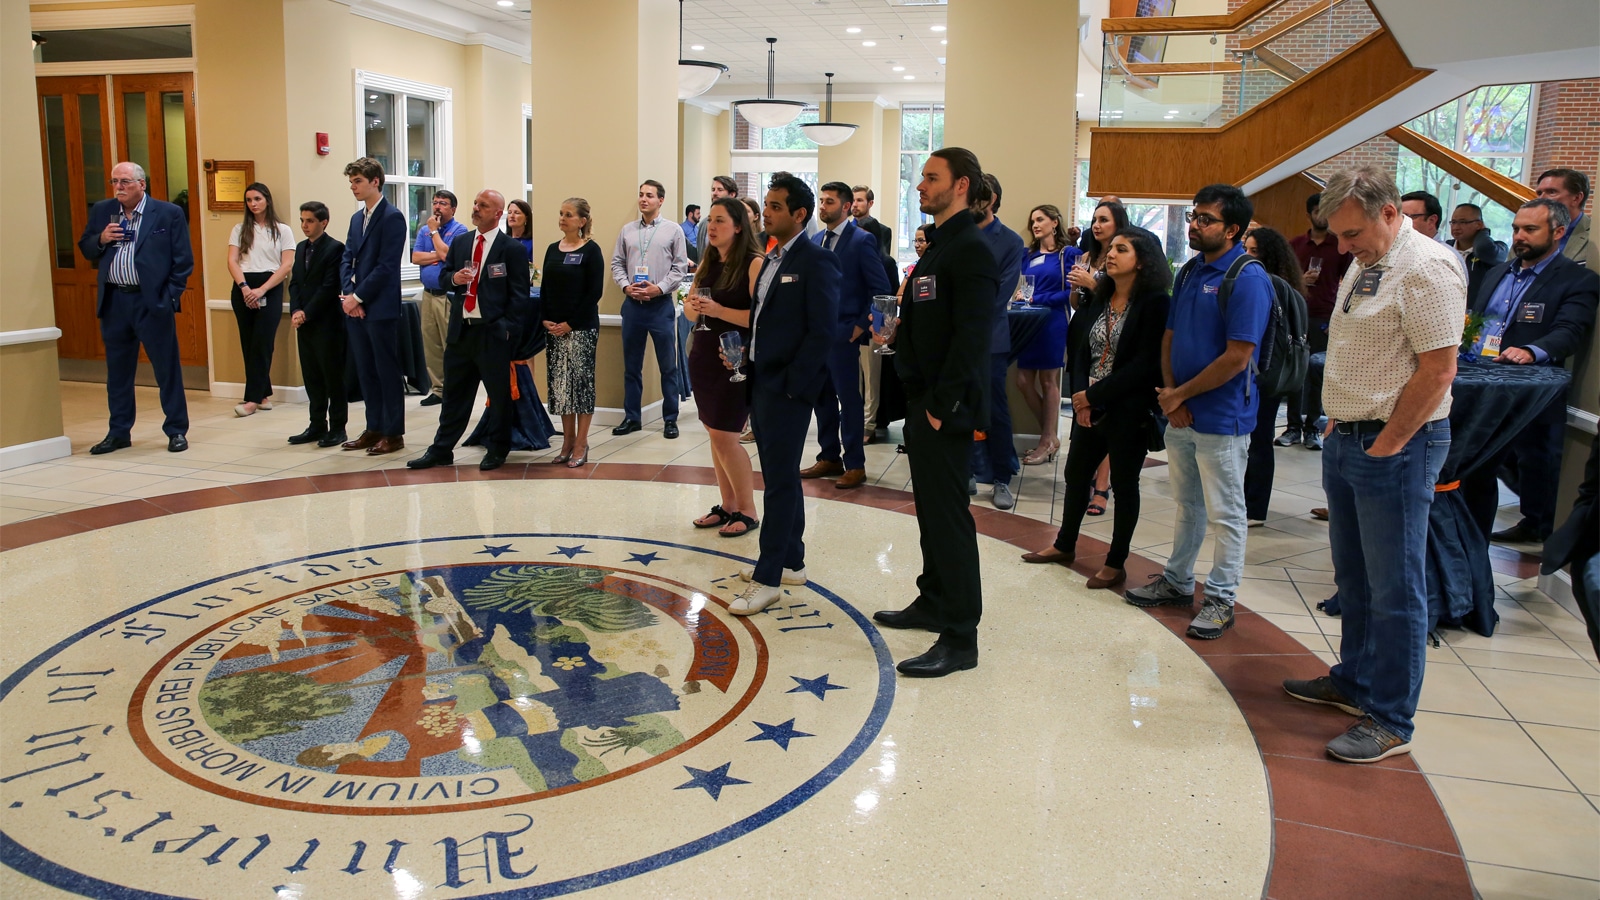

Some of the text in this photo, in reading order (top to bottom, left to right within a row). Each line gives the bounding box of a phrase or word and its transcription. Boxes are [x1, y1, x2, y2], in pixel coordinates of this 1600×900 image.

[155, 578, 500, 801] CIVIUM IN MORIBUS REI PUBLICAE SALUS
[697, 629, 731, 659] GOD
[697, 661, 730, 677] IN
[0, 556, 538, 894] University of Florida
